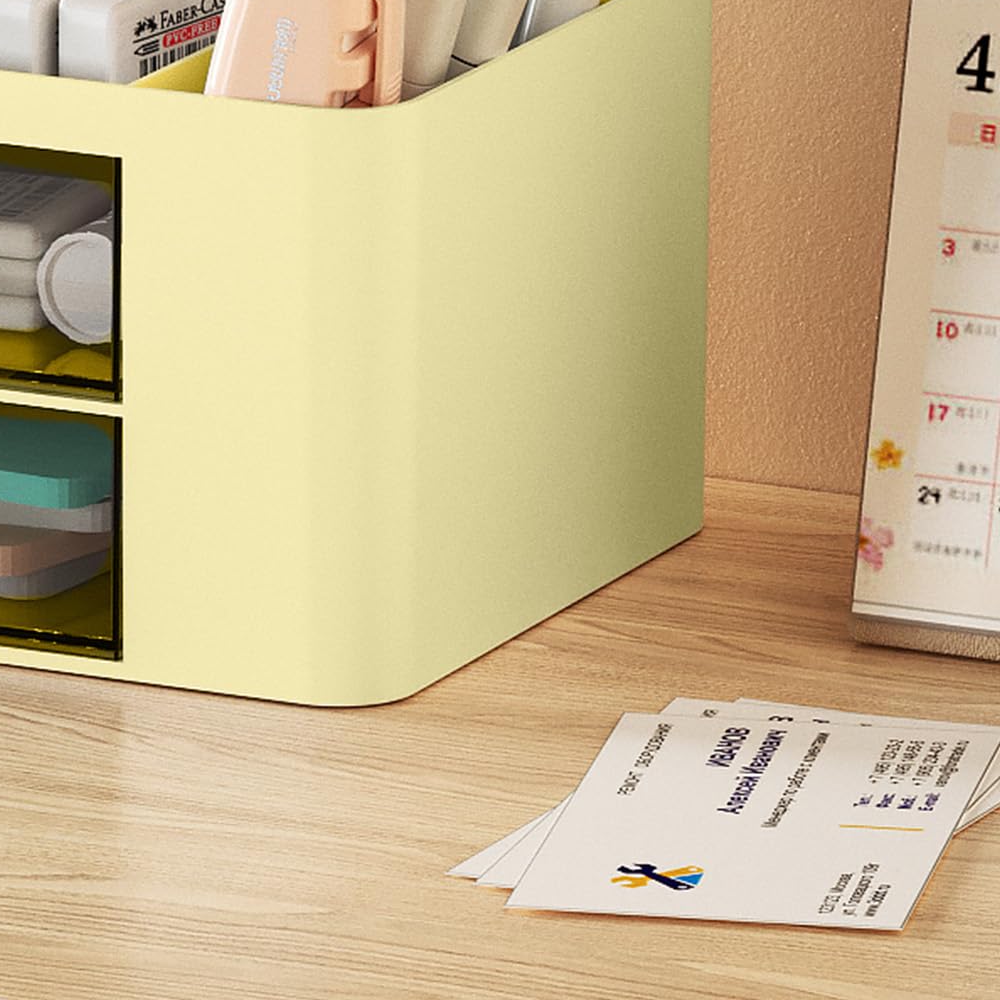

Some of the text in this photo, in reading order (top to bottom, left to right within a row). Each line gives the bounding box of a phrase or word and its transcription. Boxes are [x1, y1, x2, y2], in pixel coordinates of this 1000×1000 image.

[955, 33, 996, 94] 4
[941, 237, 957, 258] 3
[936, 319, 960, 340] 10
[928, 402, 950, 423] 17
[917, 484, 943, 506] 24
[705, 727, 751, 767] ИВАНОВ
[716, 776, 761, 815] Алексей
[739, 729, 788, 774] Иванович
